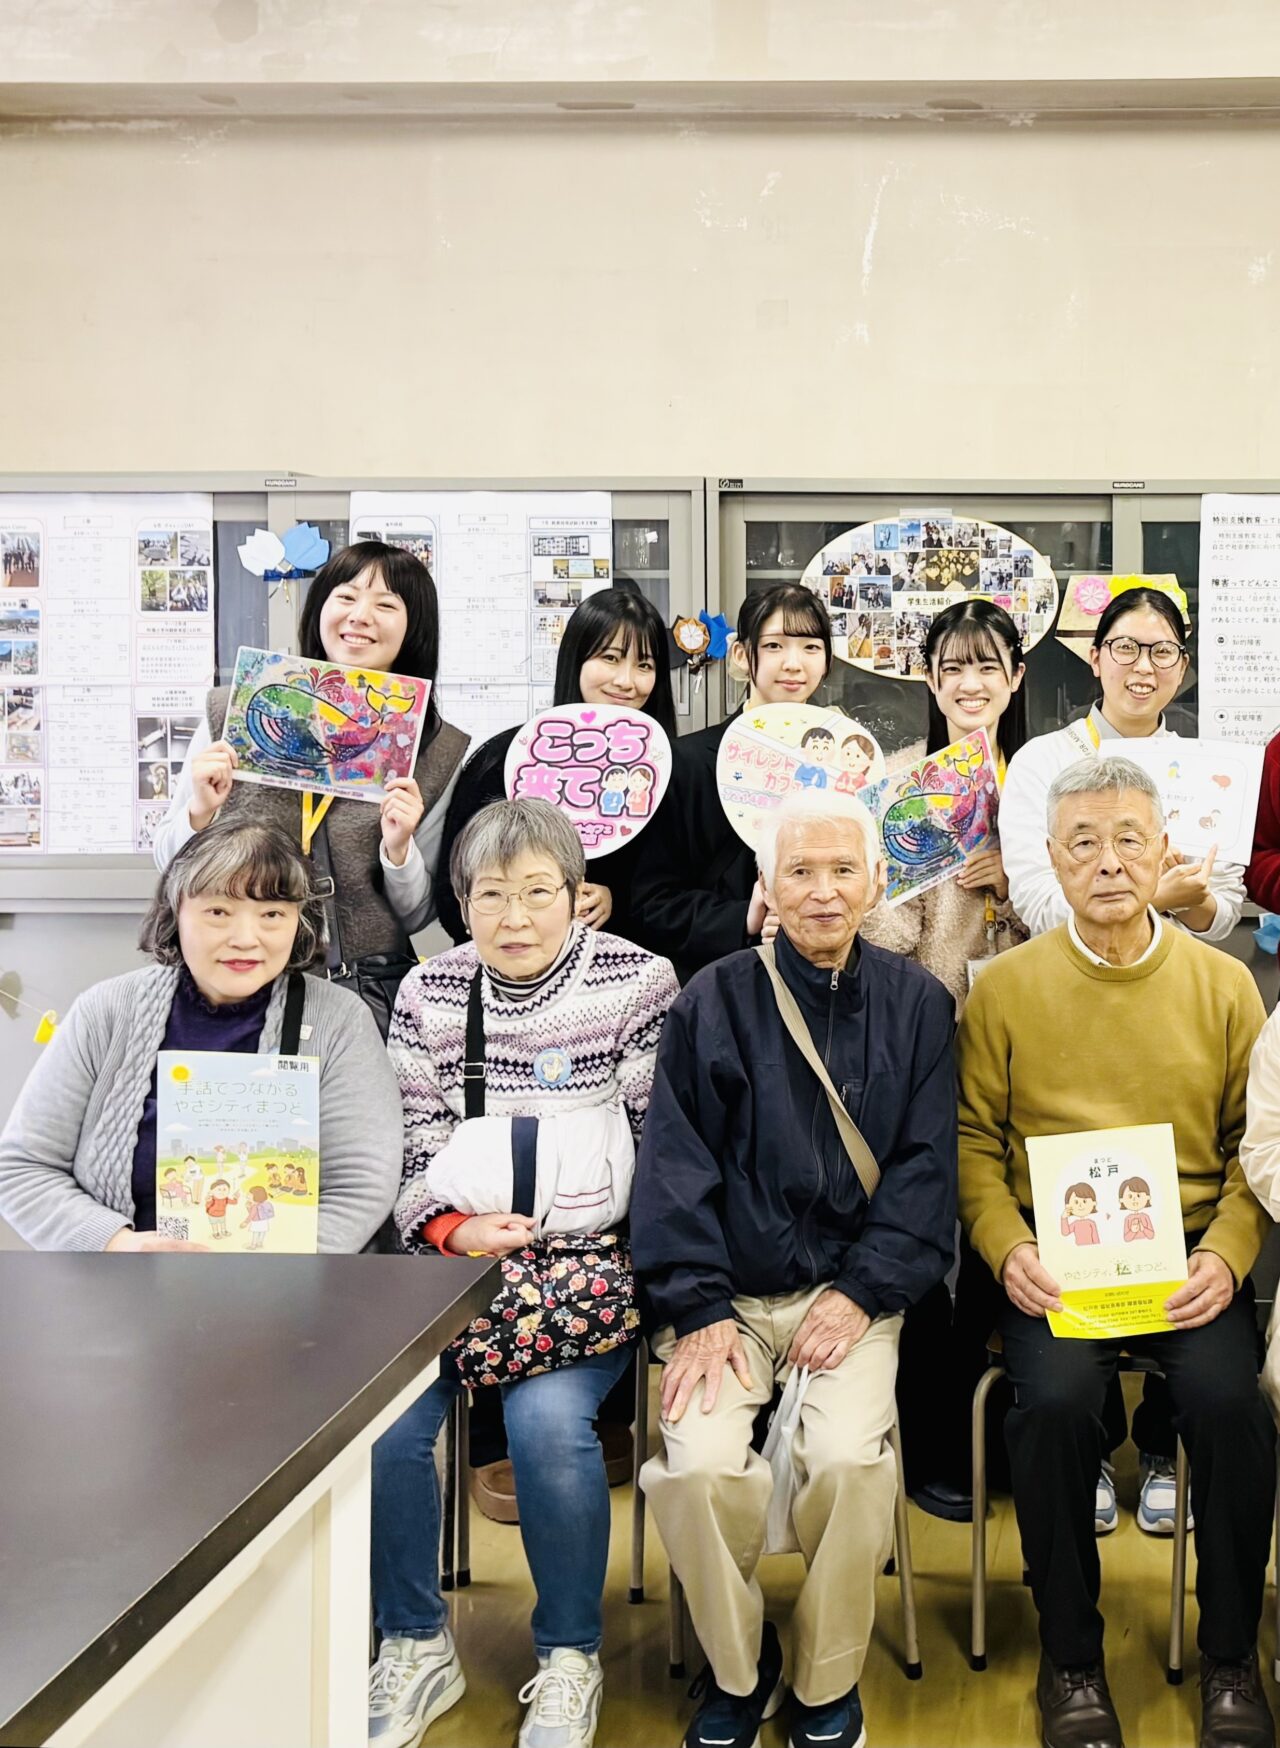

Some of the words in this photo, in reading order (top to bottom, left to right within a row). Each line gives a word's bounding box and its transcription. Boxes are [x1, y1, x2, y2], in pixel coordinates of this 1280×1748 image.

[907, 596, 952, 606] 学生生活紹介
[531, 719, 650, 764] こっち
[726, 742, 795, 771] サイレント
[513, 763, 602, 808] 来て
[277, 1059, 310, 1073] 閲覧用
[1093, 1157, 1113, 1165] まつど
[1088, 1164, 1120, 1179] 松戸
